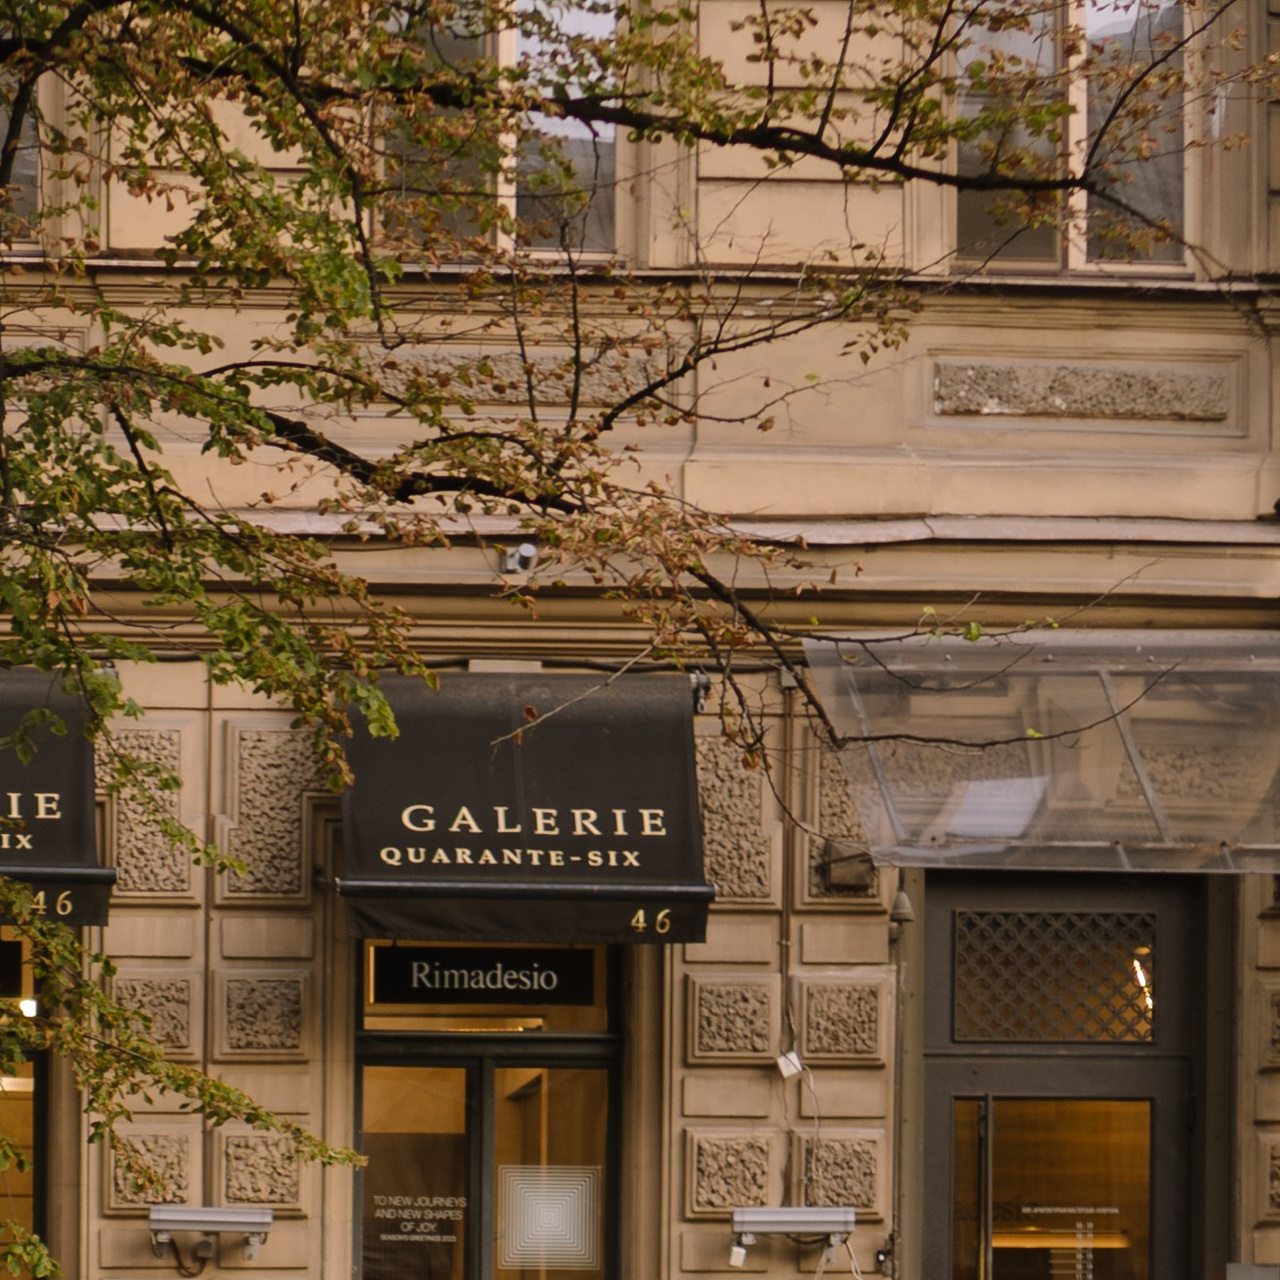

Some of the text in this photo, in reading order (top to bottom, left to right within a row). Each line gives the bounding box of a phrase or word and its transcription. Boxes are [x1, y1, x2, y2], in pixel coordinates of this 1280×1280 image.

[401, 804, 667, 836] GALERIE
[380, 846, 641, 868] QUARANTE-SIX
[29, 890, 73, 916] 46
[630, 908, 671, 934] 46
[410, 960, 558, 991] Rimadesio
[373, 1195, 467, 1208] TO NEW JOURNEYS
[374, 1209, 463, 1220] AND NEW SHAPES
[400, 1221, 415, 1232] OF
